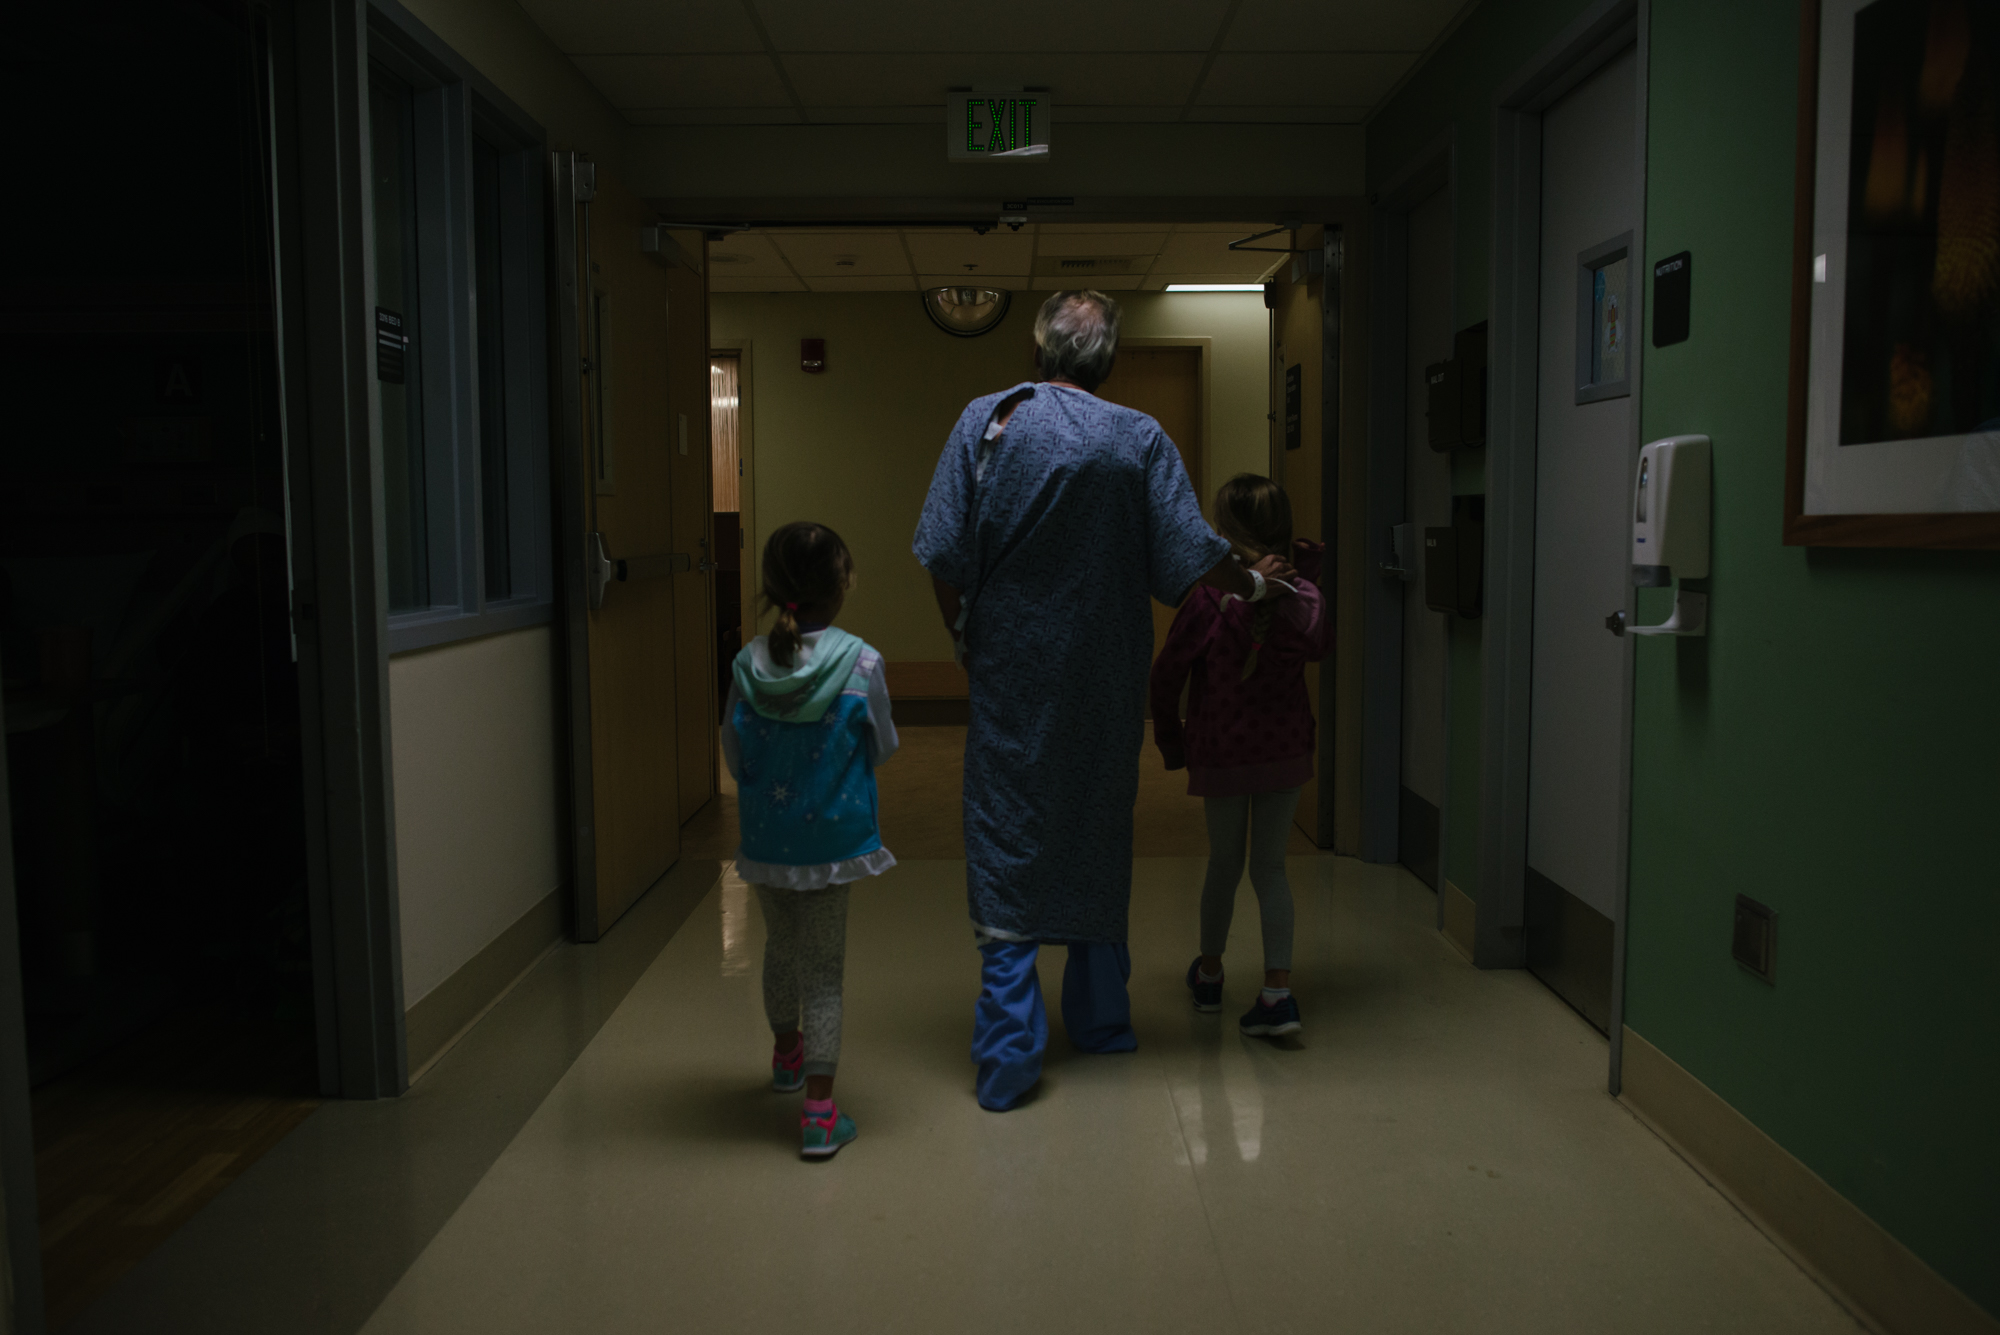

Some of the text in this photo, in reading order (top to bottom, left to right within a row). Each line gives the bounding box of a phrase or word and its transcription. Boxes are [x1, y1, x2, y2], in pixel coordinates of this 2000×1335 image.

[967, 99, 1036, 151] EXIT
[1655, 259, 1683, 278] NUTRITION
[388, 315, 397, 326] BED
[164, 363, 193, 397] A
